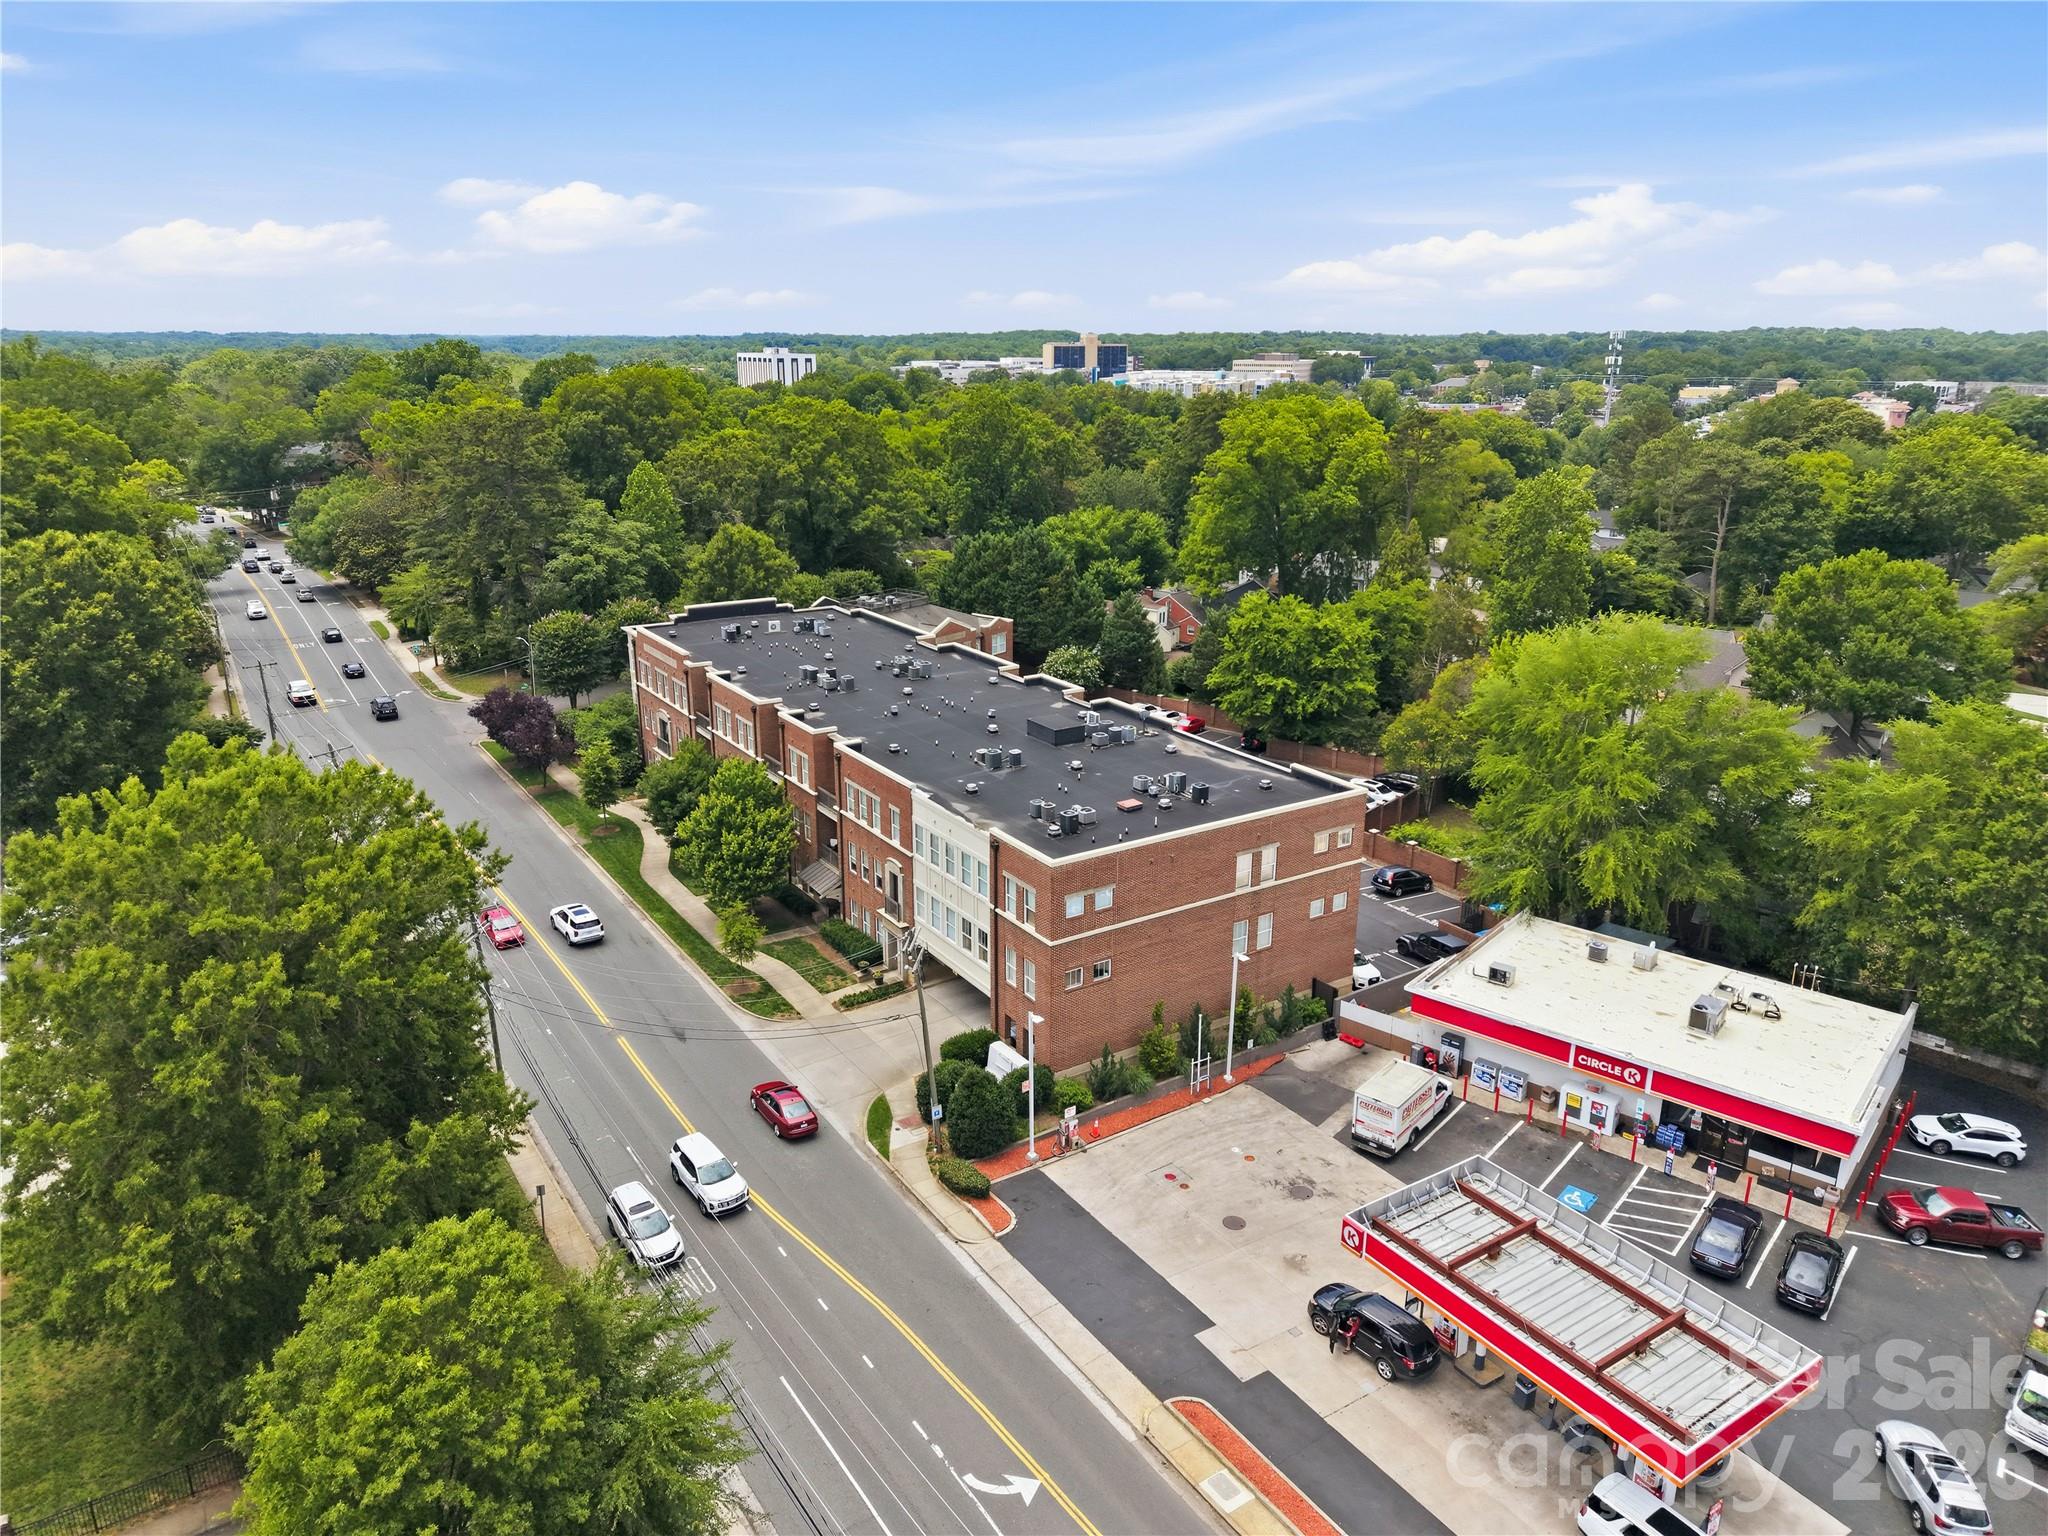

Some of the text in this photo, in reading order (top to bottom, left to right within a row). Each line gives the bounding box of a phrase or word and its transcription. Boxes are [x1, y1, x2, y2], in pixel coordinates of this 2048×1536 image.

[1578, 1055, 1640, 1083] CIRCLE K
[1345, 1228, 1358, 1247] K
